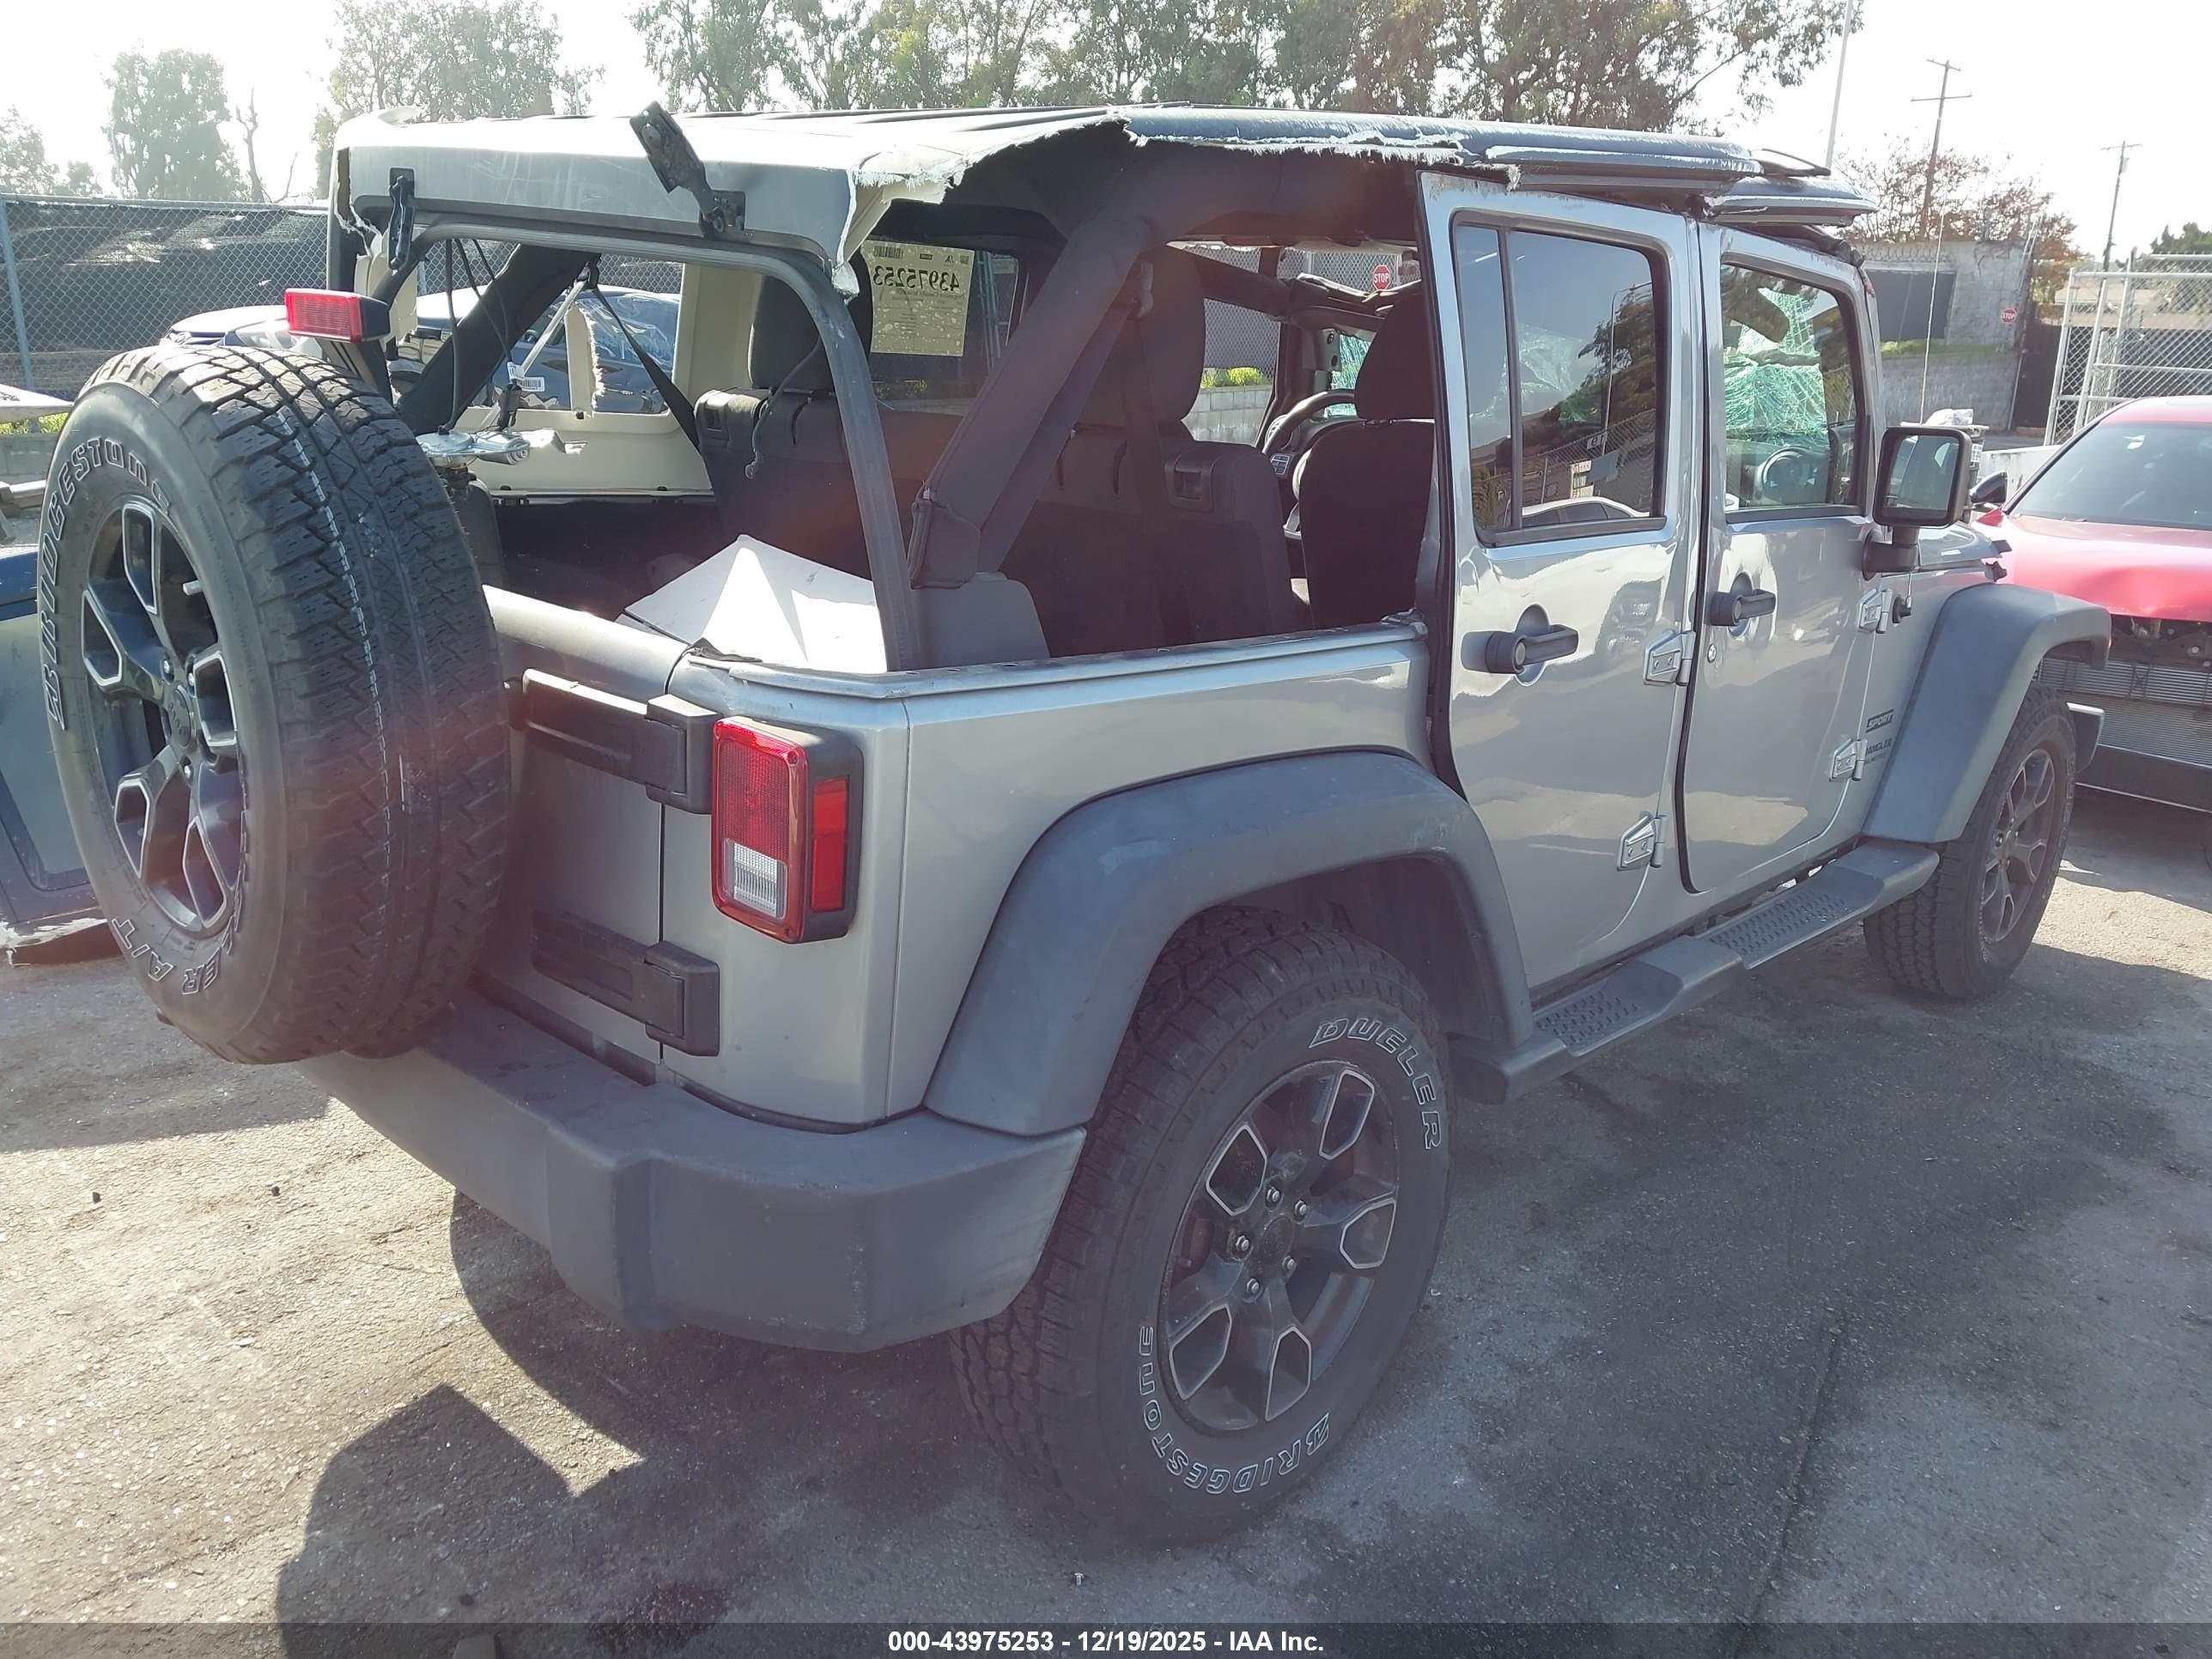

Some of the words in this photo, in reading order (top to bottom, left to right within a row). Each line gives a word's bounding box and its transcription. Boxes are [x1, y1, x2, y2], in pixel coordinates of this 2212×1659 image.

[1374, 273, 1389, 283] STOP
[40, 435, 171, 731] BRIDGESTONE
[1868, 713, 1893, 729] SPORT
[1308, 1018, 1442, 1150] DUELER
[1139, 1326, 1330, 1494] BRIDGESTONE
